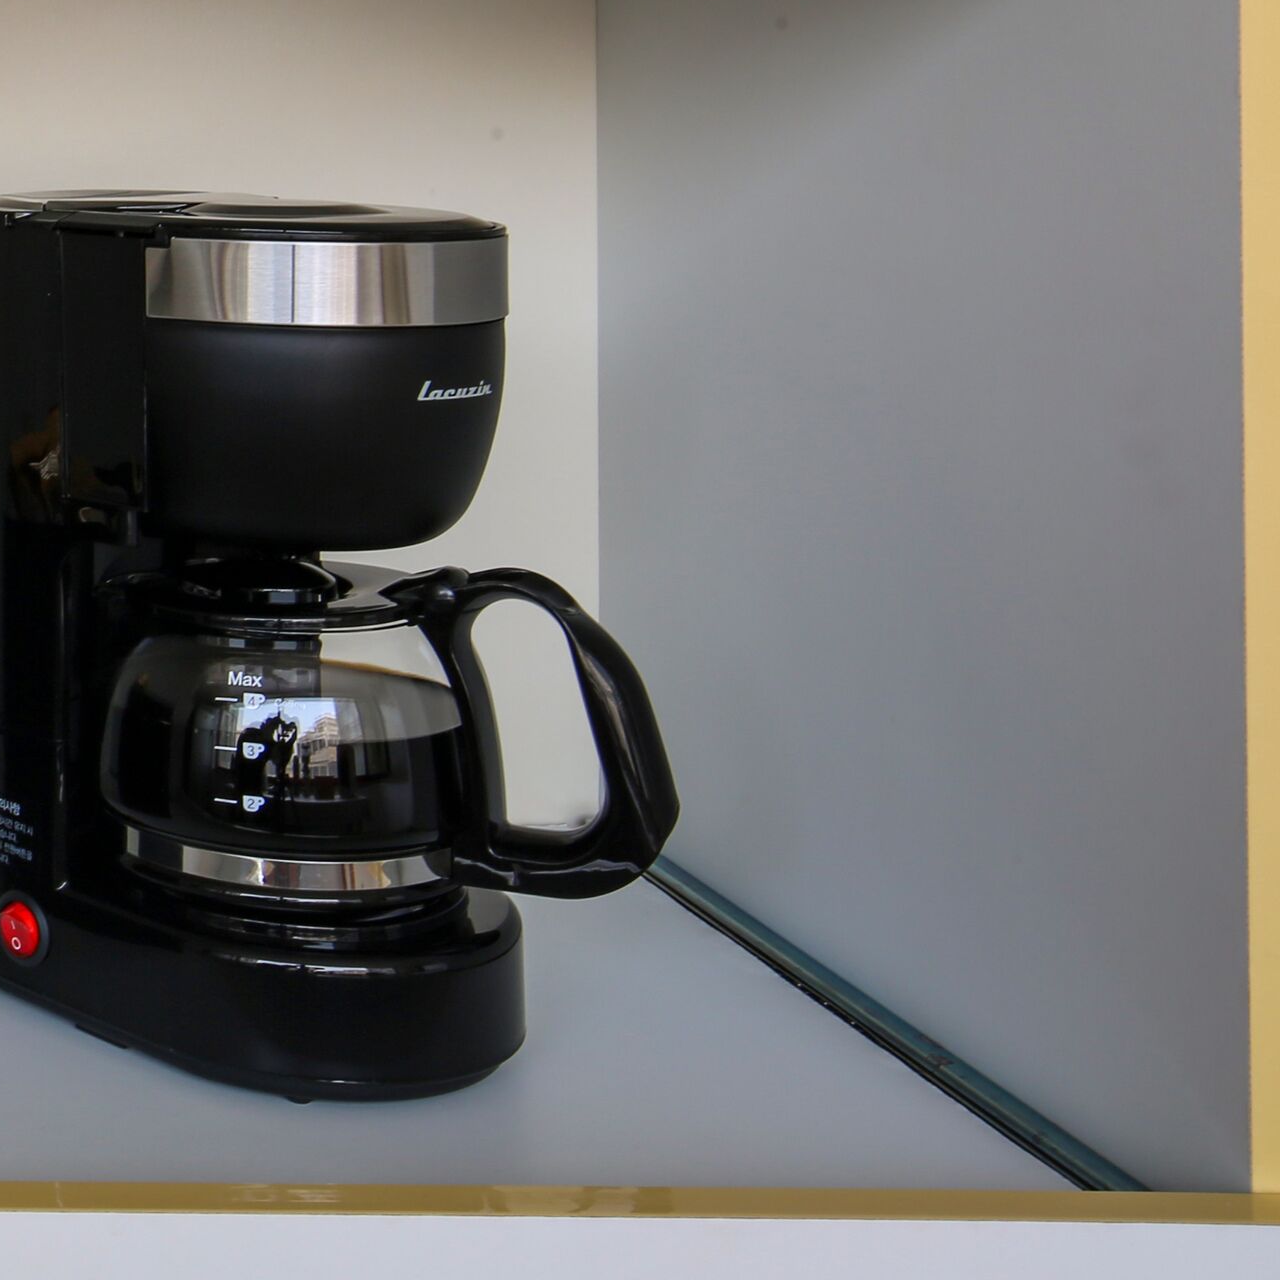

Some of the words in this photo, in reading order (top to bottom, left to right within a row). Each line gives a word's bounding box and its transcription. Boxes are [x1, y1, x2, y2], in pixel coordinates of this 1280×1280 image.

[416, 379, 493, 402] Lacuzin
[227, 670, 263, 688] Max
[246, 744, 256, 757] 3
[246, 798, 256, 810] 2
